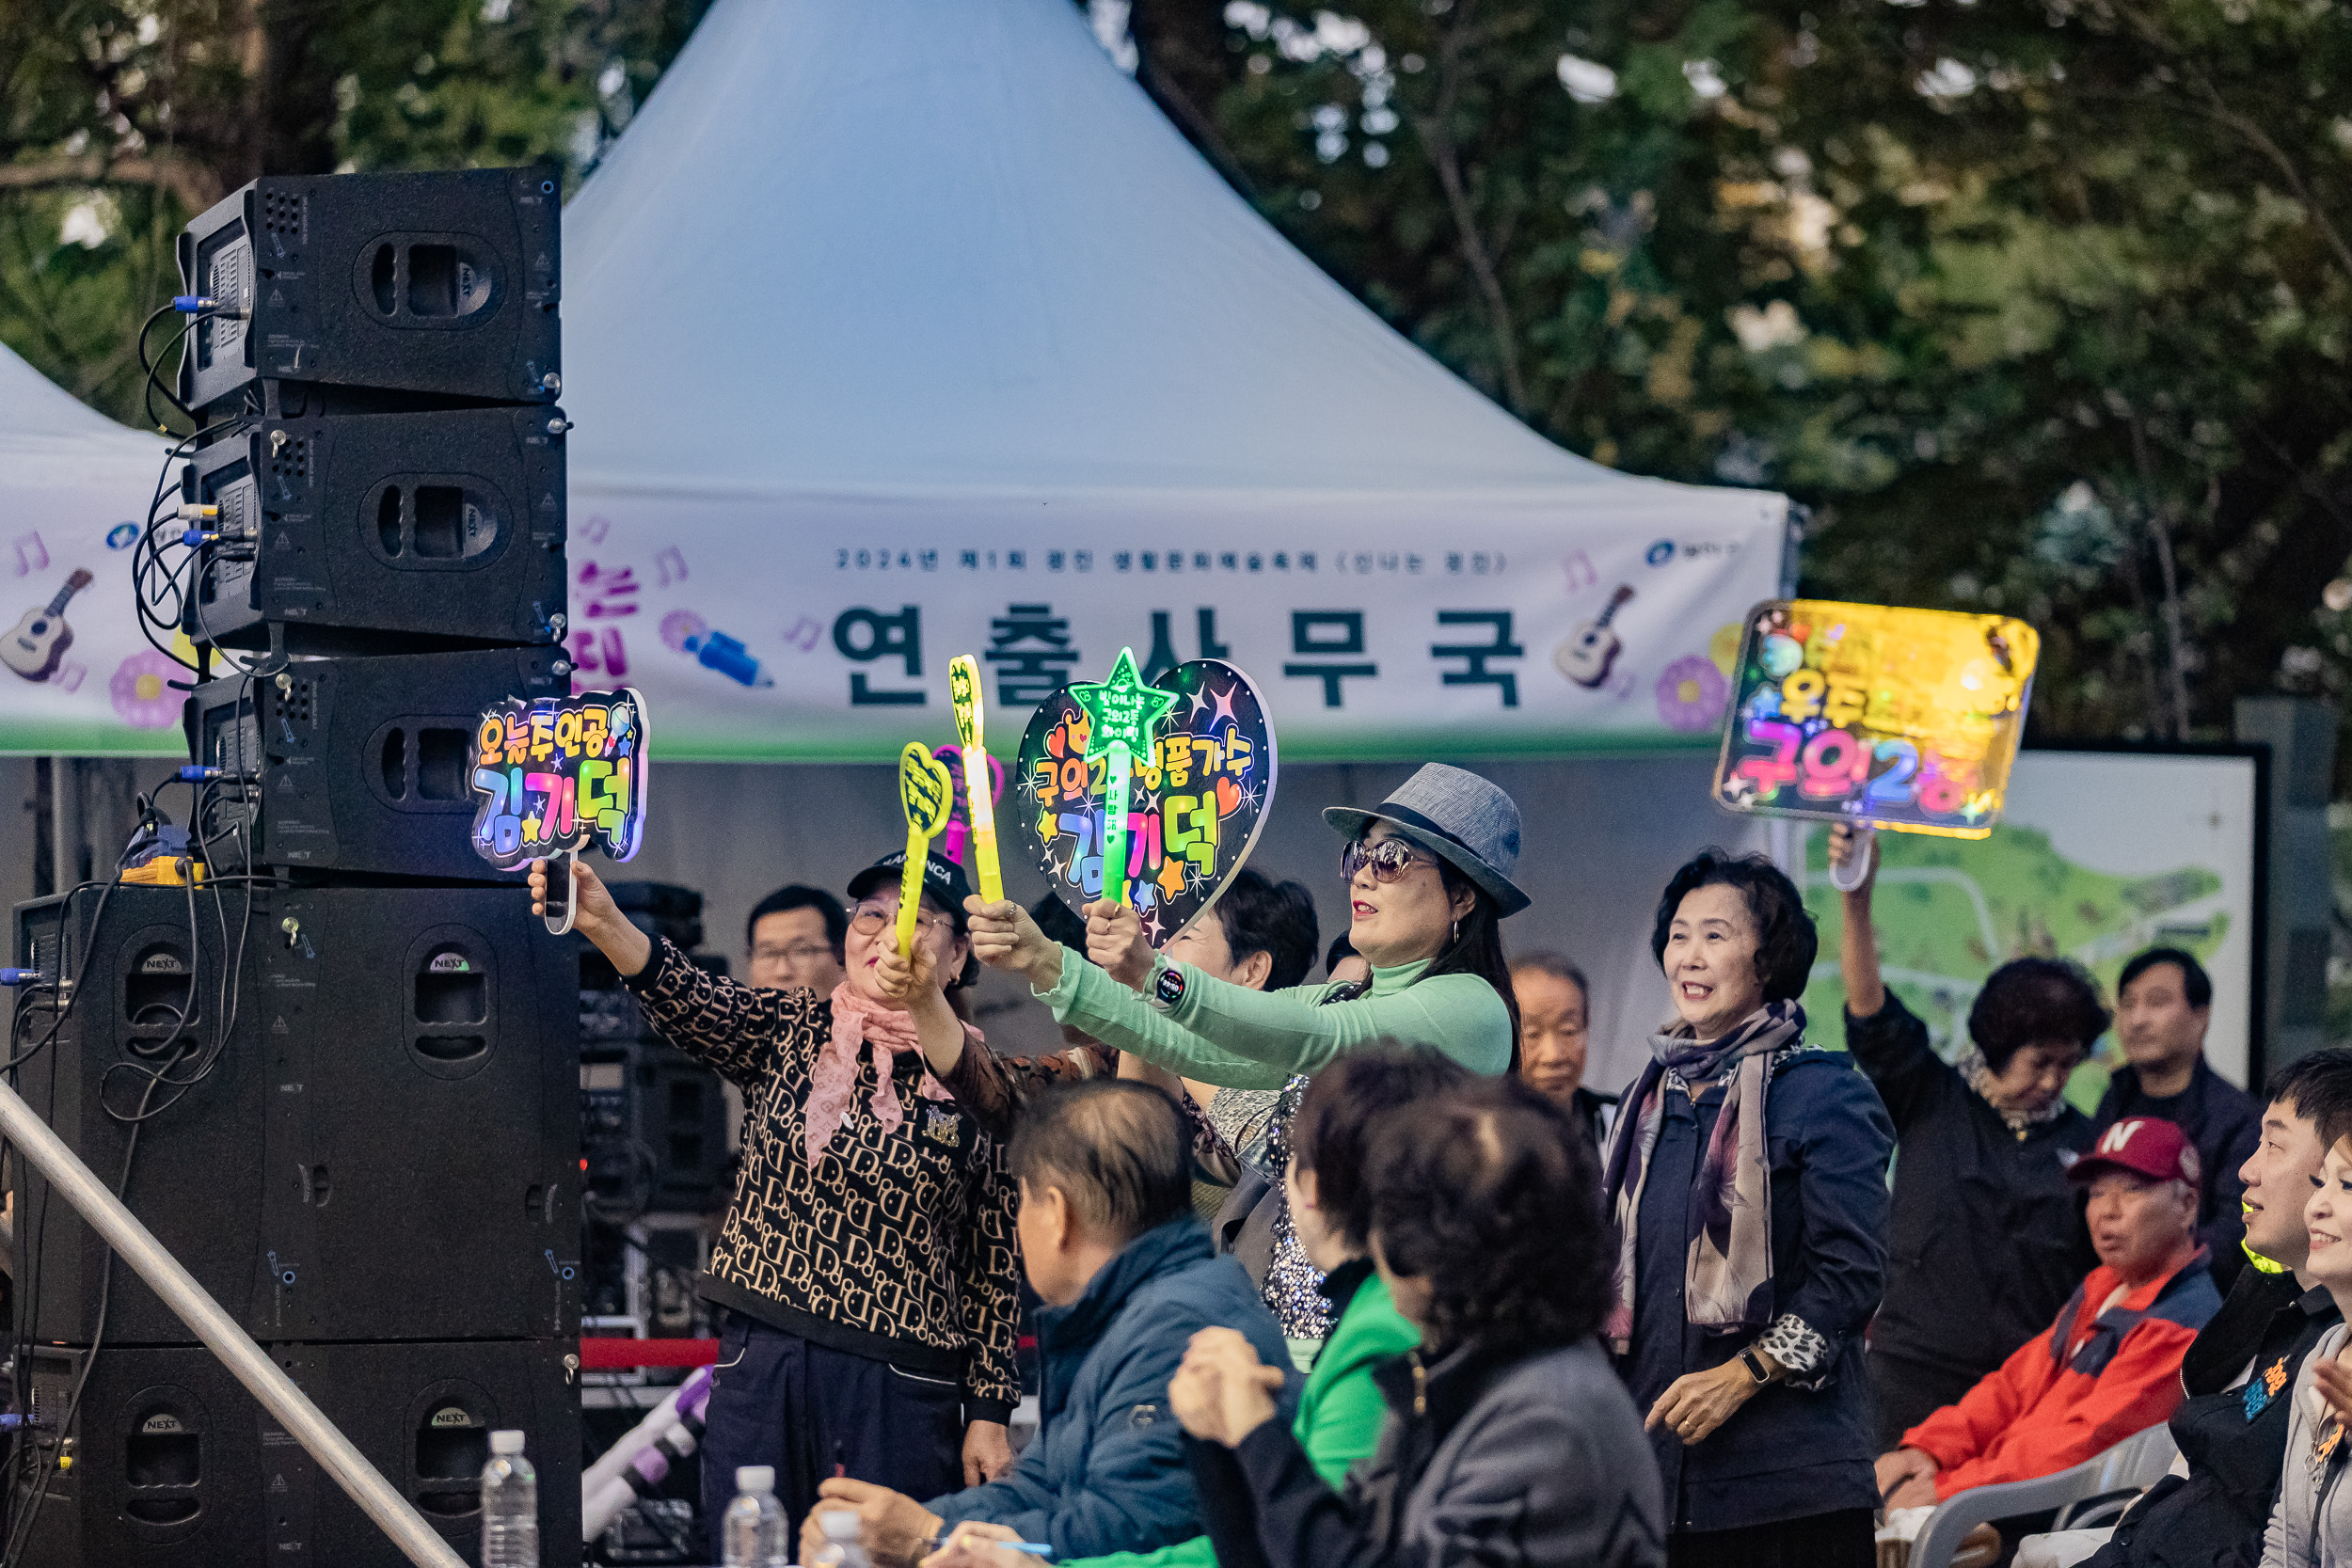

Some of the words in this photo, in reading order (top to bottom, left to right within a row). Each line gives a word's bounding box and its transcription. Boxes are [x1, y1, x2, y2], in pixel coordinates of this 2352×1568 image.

[1102, 707, 1140, 727] 구의2동
[1036, 756, 1118, 807] 구의2
[474, 757, 631, 853] 김기덕
[1059, 790, 1217, 895] 김기덕
[146, 958, 177, 970] NEXT
[435, 958, 465, 970] NEXT
[2101, 1120, 2144, 1154] N
[147, 1419, 178, 1430] NEXT
[437, 1412, 466, 1424] NEXT
